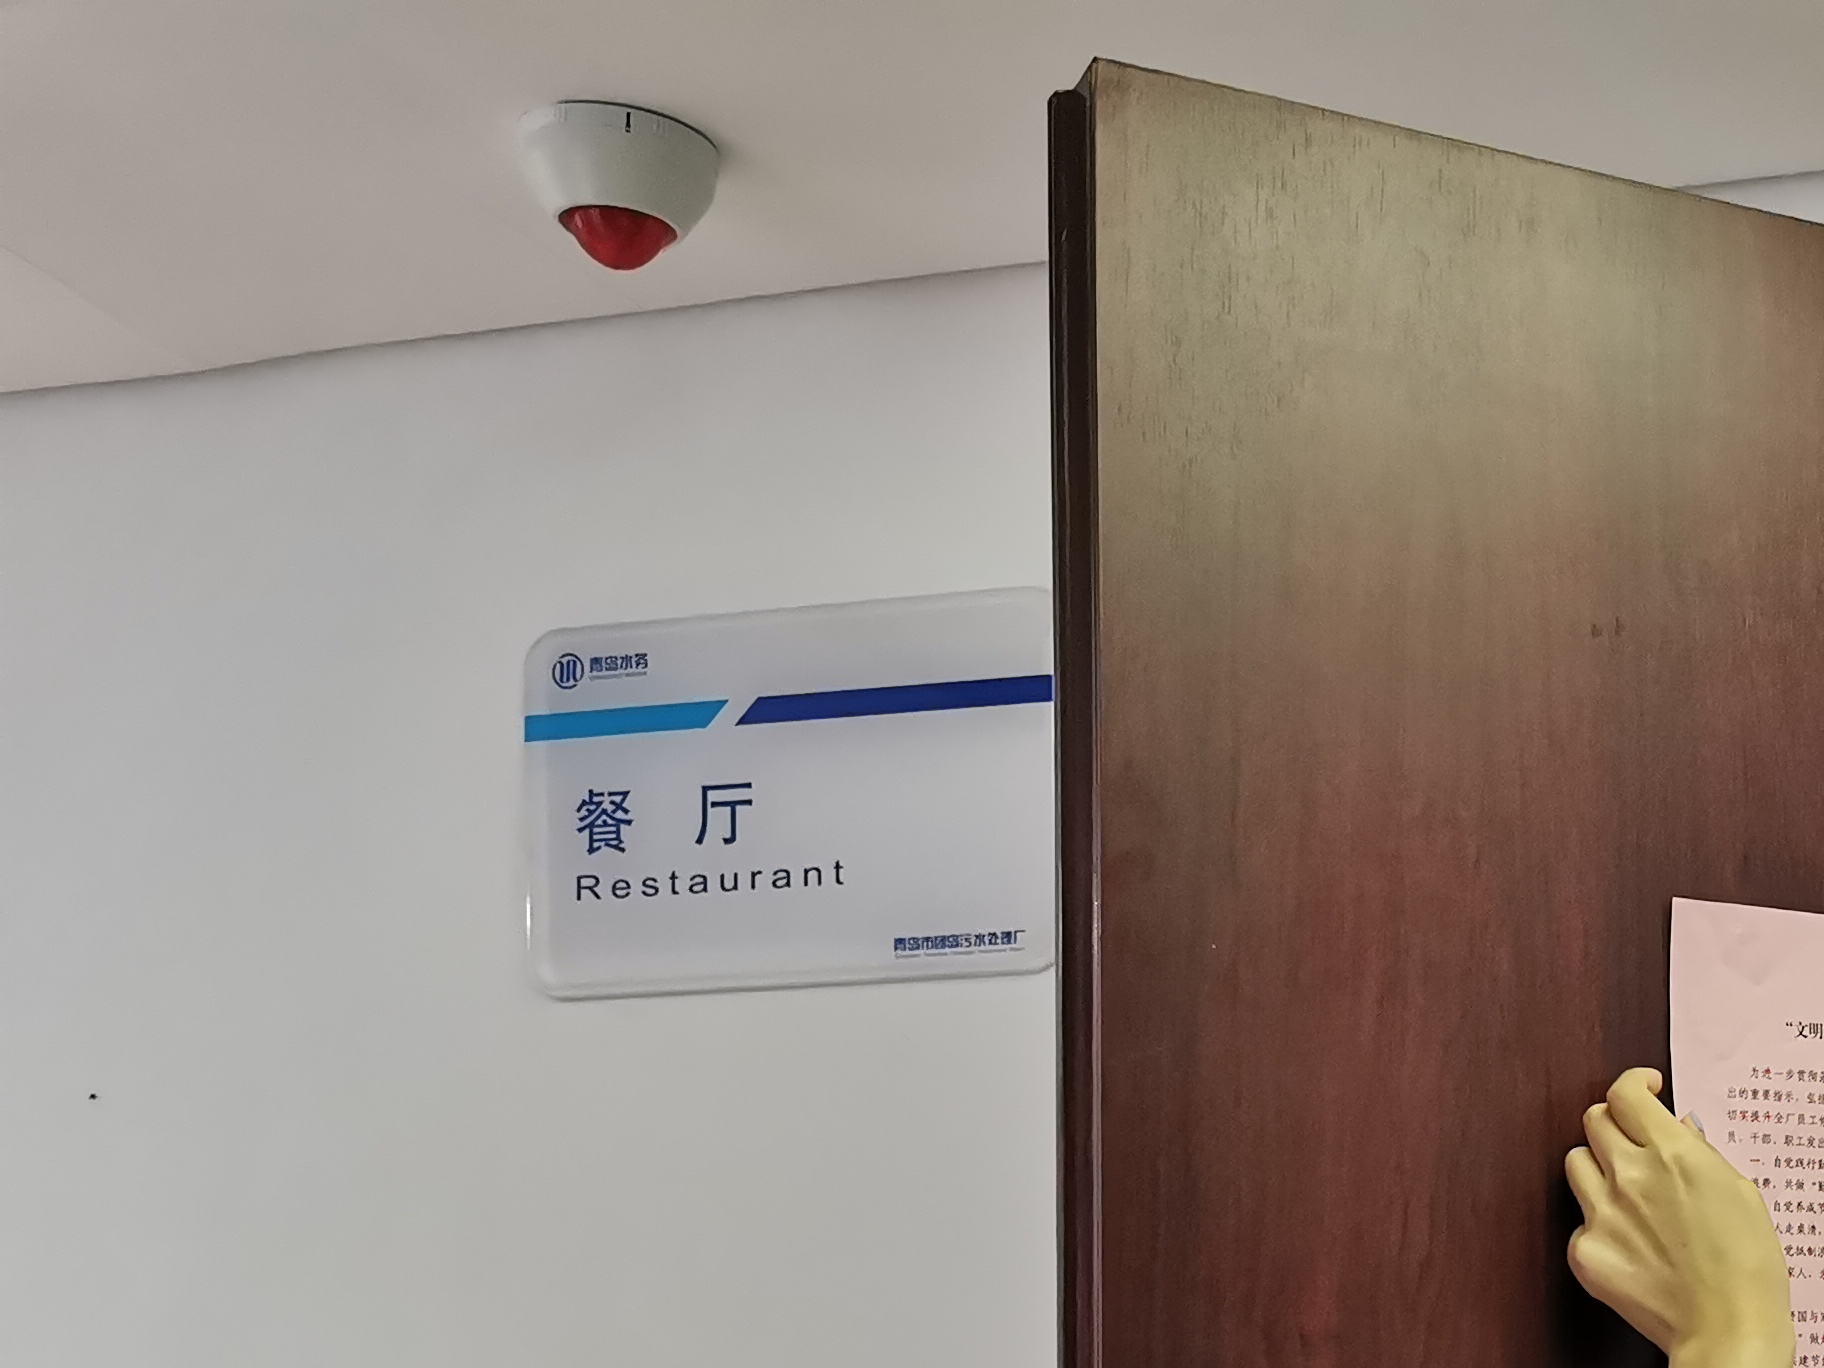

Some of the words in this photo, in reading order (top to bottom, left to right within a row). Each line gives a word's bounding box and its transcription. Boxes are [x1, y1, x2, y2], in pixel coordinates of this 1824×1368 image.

[589, 652, 649, 673] 青岛水务
[575, 780, 754, 856] 餐厅
[575, 858, 846, 901] Restaurant
